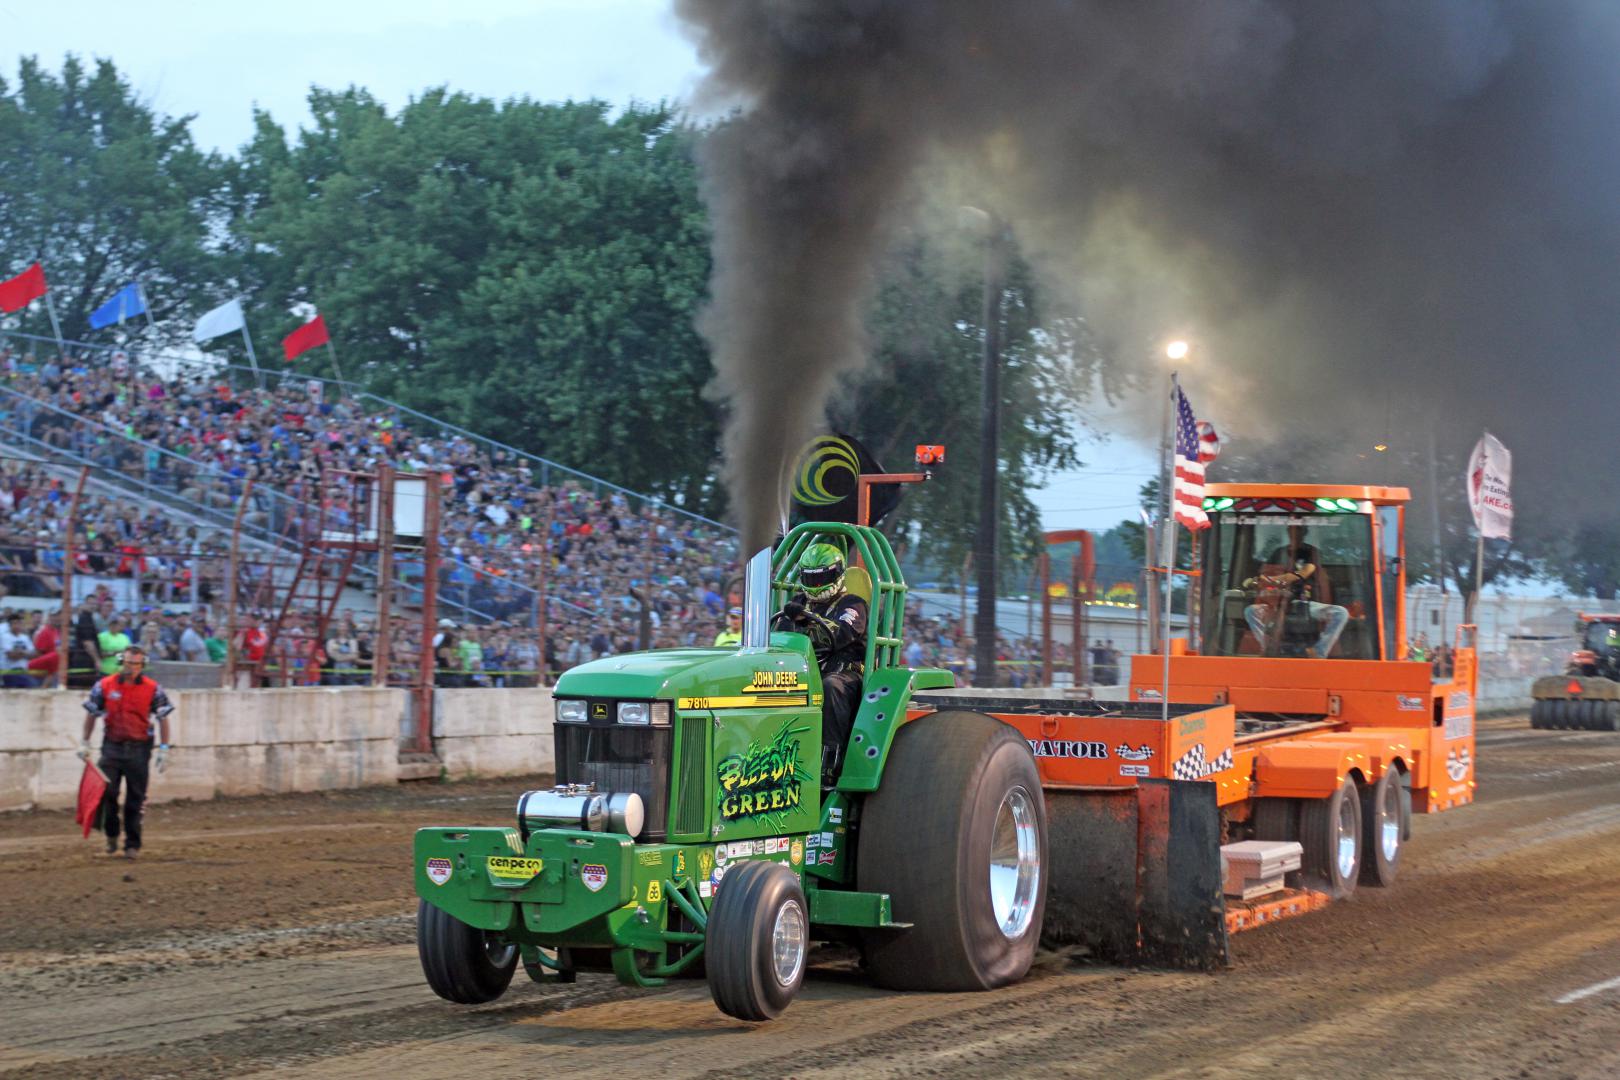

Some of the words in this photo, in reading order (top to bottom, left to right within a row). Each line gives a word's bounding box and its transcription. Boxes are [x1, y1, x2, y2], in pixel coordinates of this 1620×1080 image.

[752, 671, 774, 687] JOHN
[775, 671, 798, 687] DEERE
[688, 698, 709, 710] 7810
[722, 783, 800, 817] GREEN
